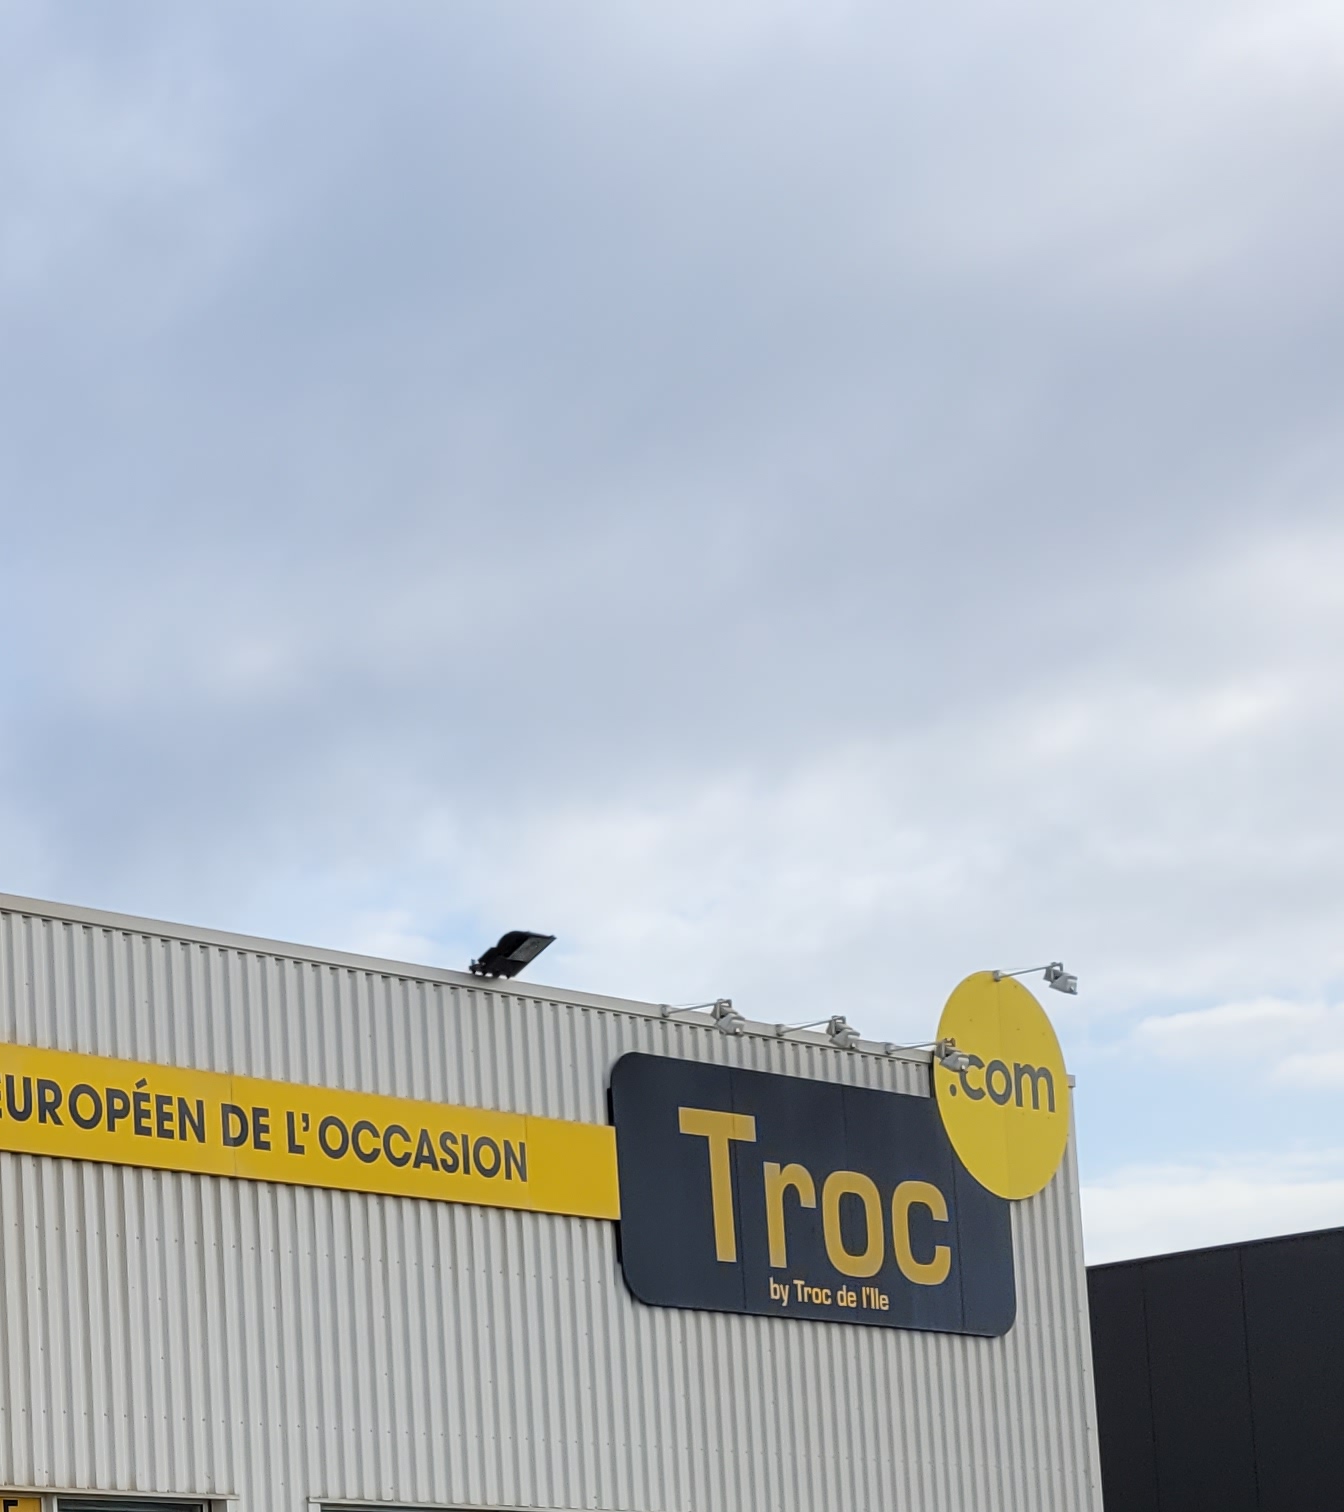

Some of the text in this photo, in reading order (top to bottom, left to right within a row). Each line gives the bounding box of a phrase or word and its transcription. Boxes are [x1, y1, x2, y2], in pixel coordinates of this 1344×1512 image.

[221, 1103, 271, 1152] DE
[285, 1111, 529, 1183] L'OCCASION
[678, 1106, 952, 1286] Troc
[769, 1277, 788, 1307] by
[793, 1279, 832, 1305] Troc
[837, 1285, 857, 1308] de
